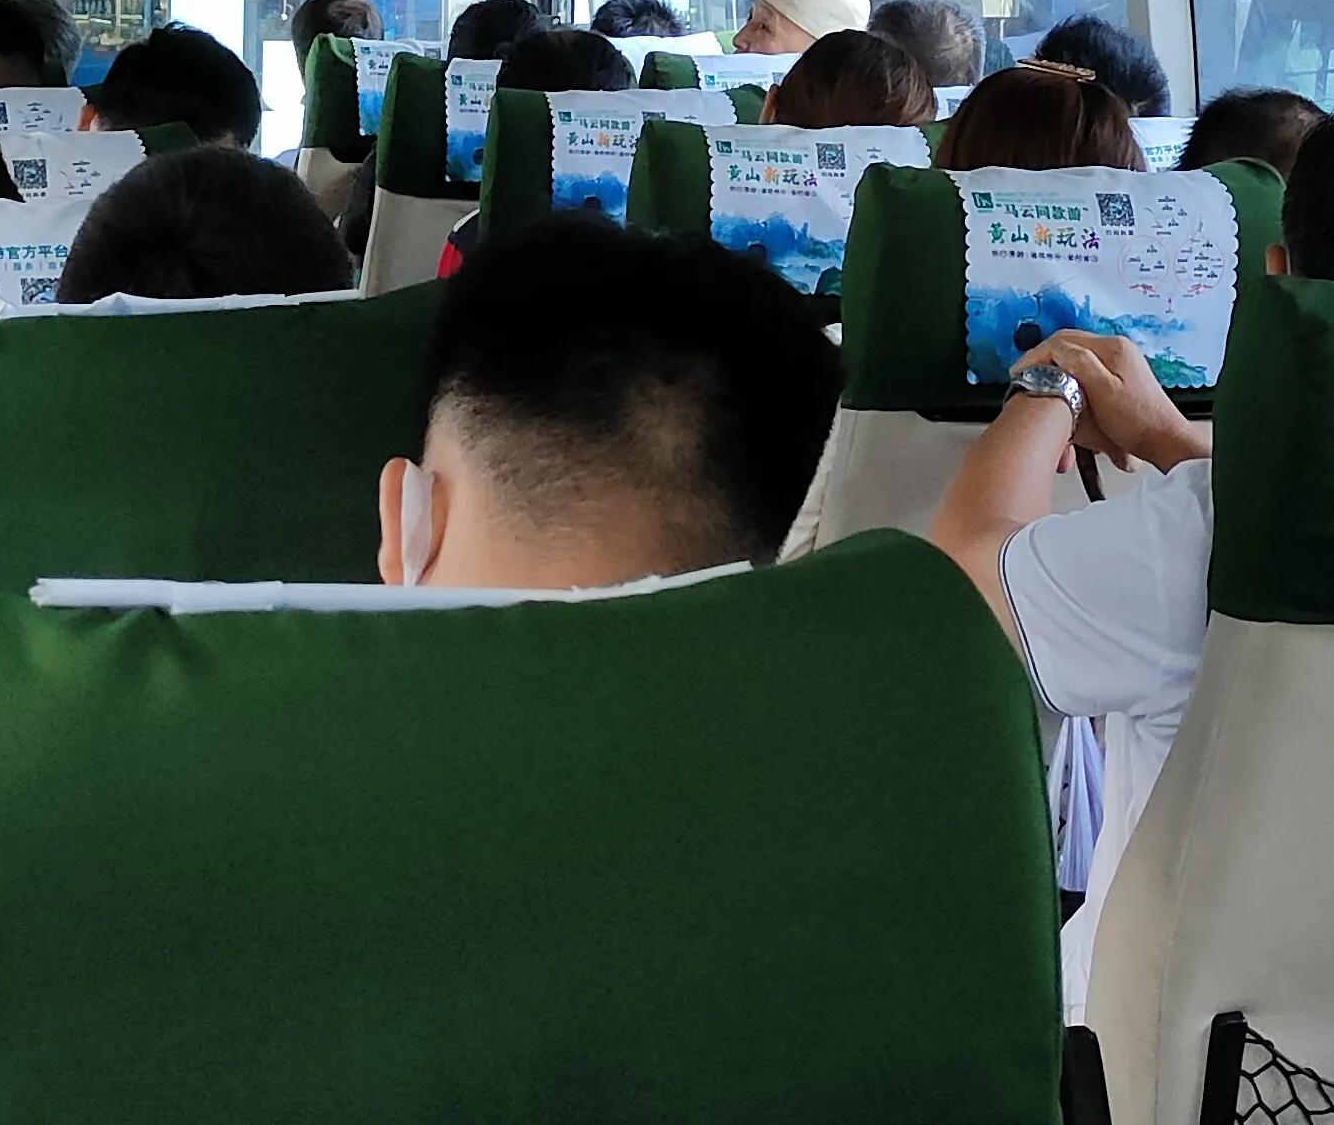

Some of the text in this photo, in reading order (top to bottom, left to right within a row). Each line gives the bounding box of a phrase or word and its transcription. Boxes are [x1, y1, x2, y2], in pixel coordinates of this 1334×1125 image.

[987, 221, 1101, 250] 黄山新玩法
